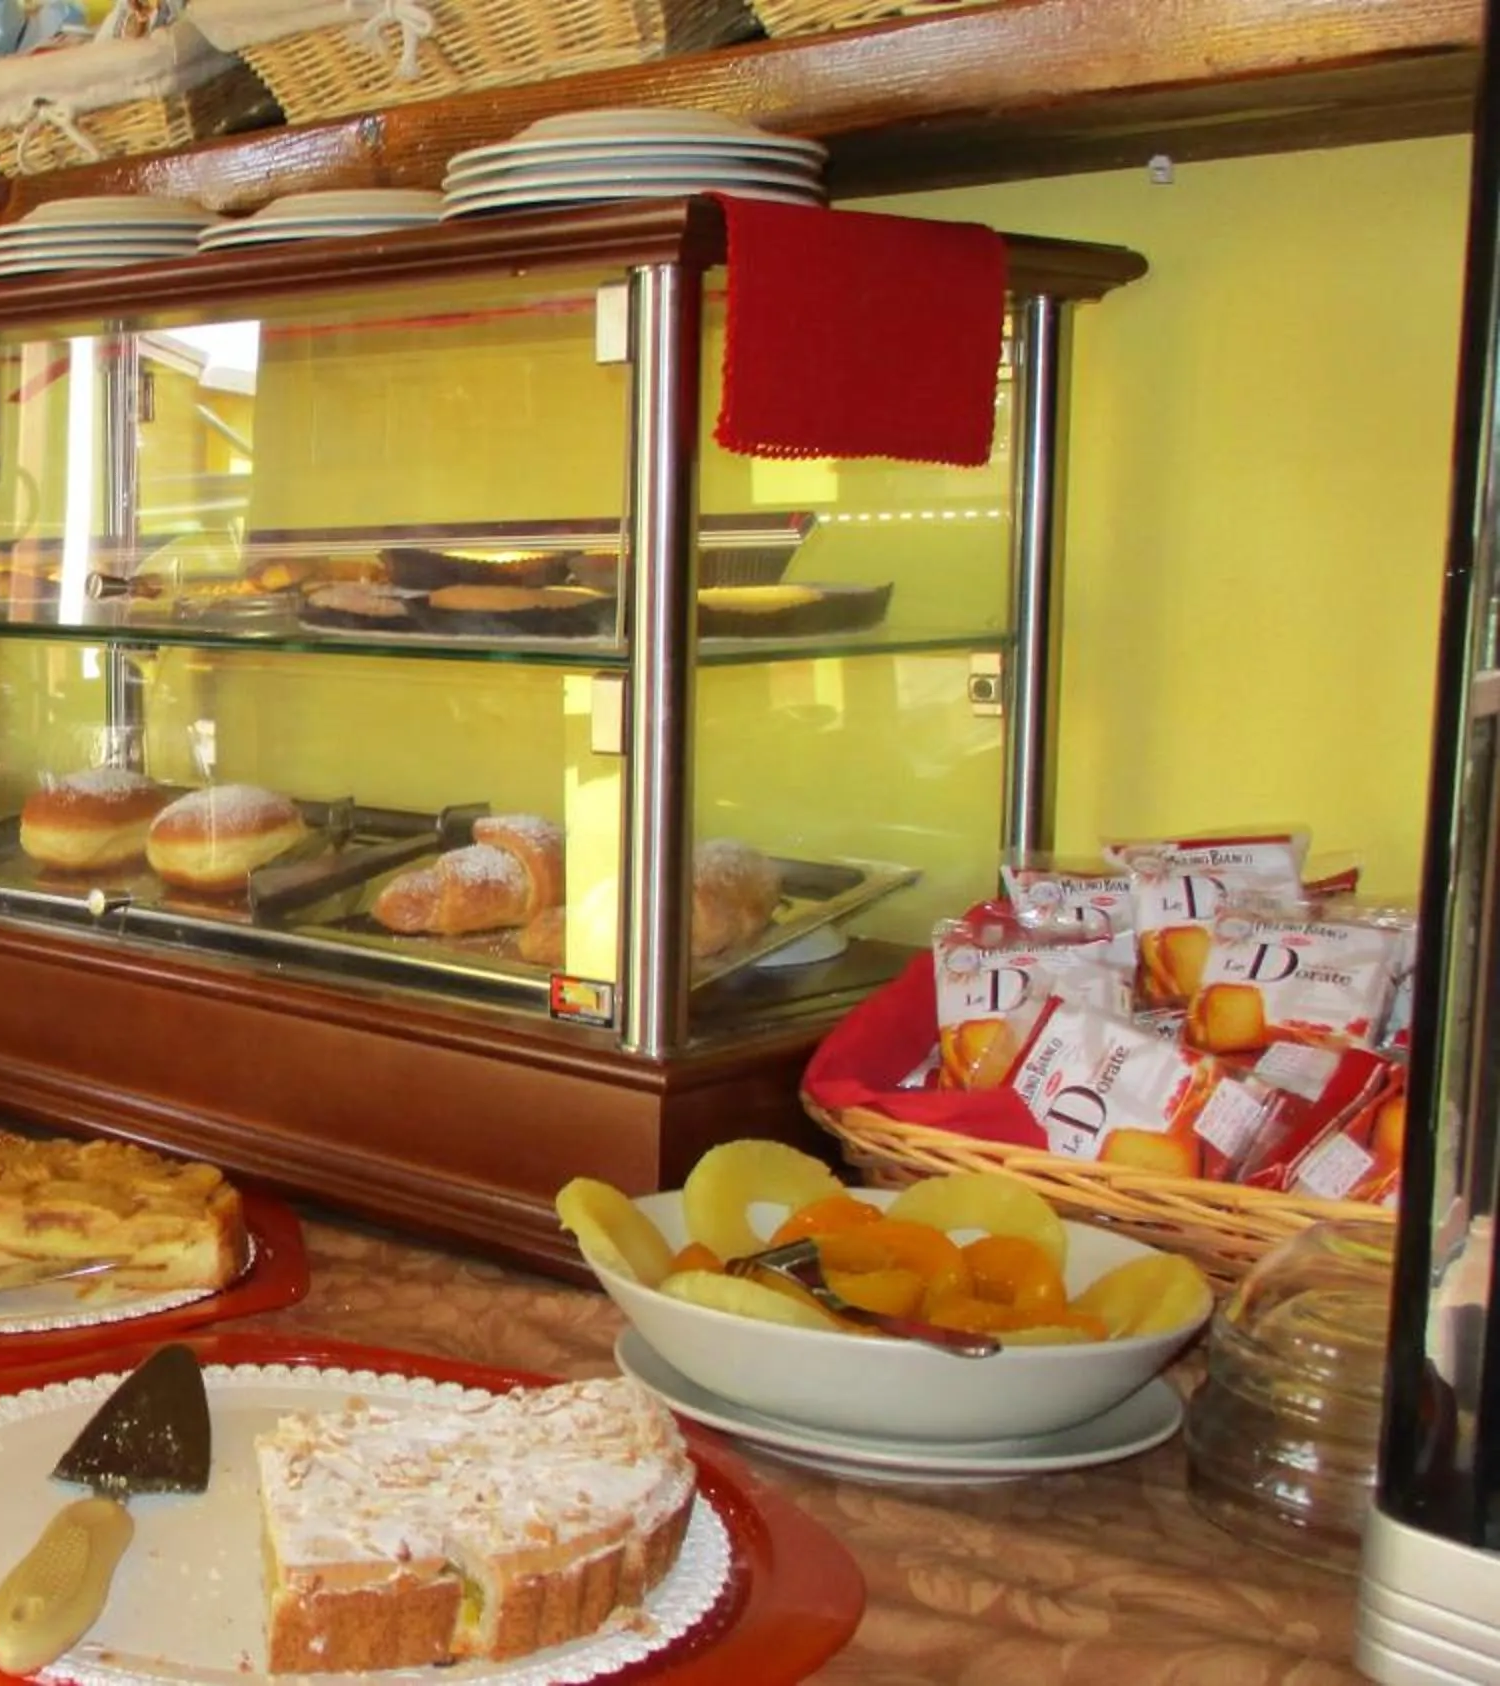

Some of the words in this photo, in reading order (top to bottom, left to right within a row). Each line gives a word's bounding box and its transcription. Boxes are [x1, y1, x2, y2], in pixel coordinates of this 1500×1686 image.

[1103, 879, 1131, 892] BIAN
[1241, 943, 1353, 987] Dorate
[1043, 1045, 1130, 1140] Dorate
